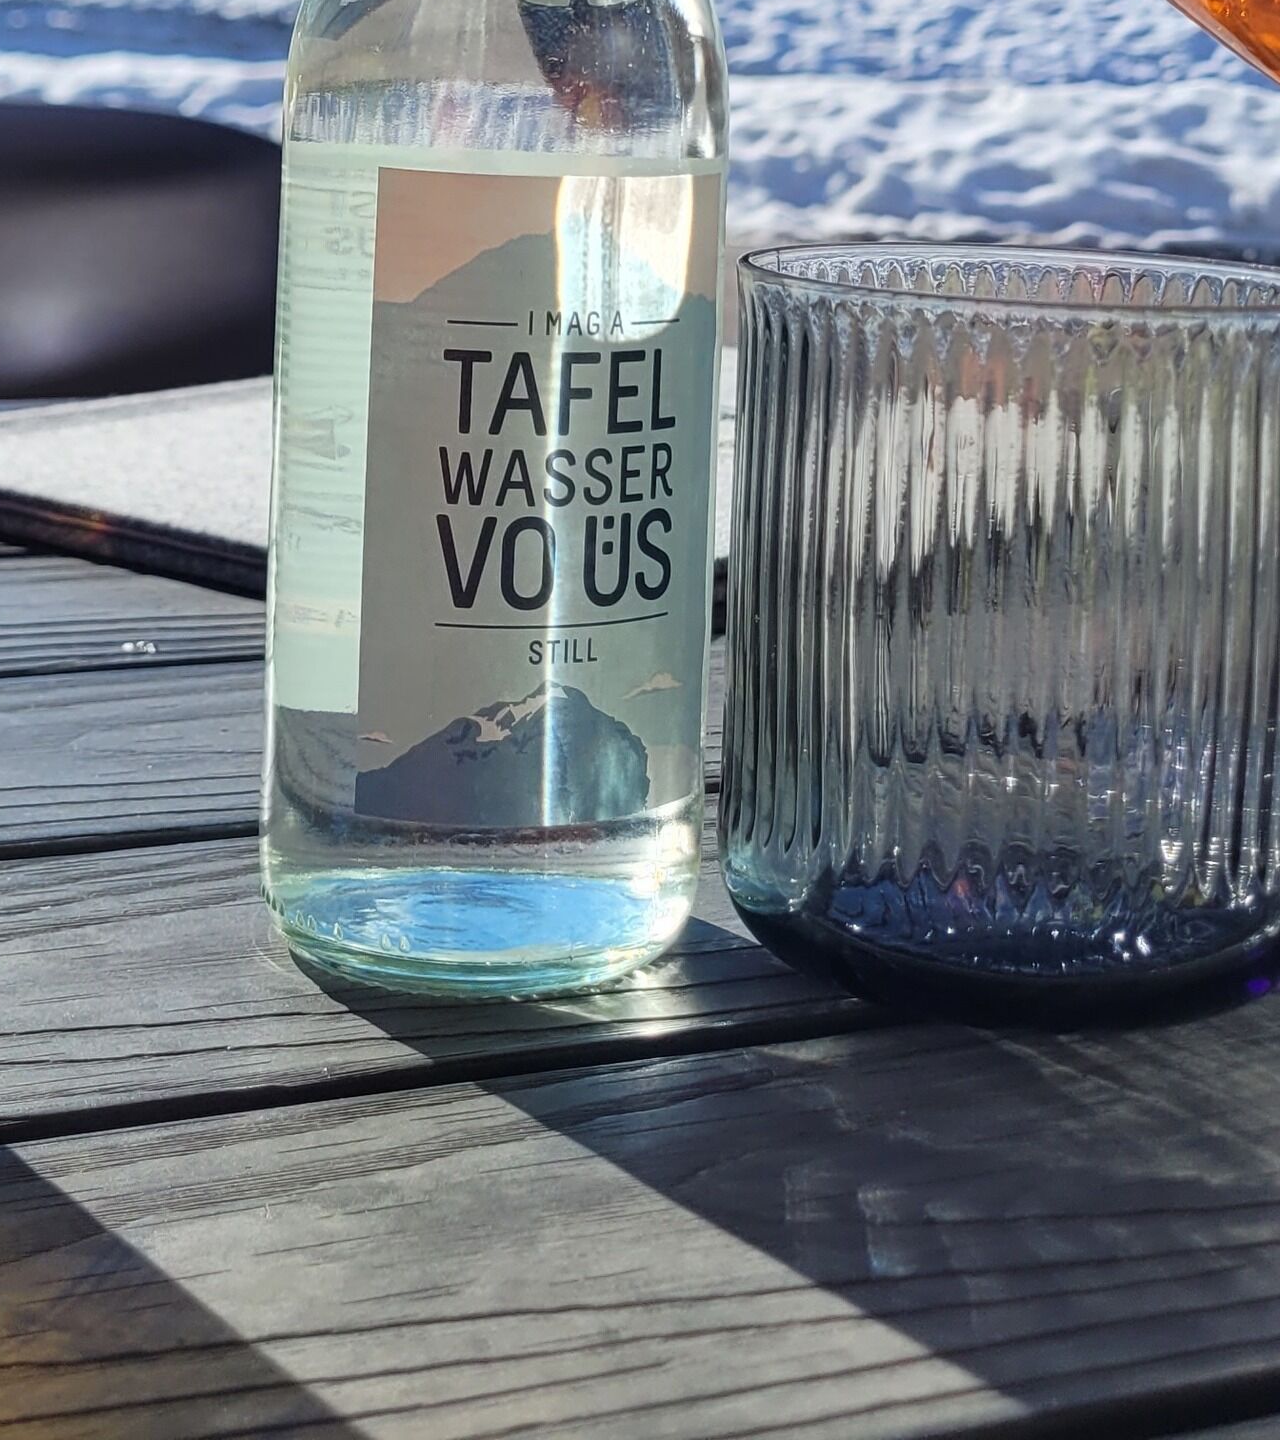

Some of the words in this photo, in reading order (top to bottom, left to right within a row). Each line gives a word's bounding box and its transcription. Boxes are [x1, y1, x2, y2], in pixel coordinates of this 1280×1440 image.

[443, 348, 676, 436] TAFEL
[439, 443, 673, 507] WASSER
[436, 513, 556, 610] VO
[583, 508, 672, 607] ÜS
[528, 637, 598, 665] STILL
